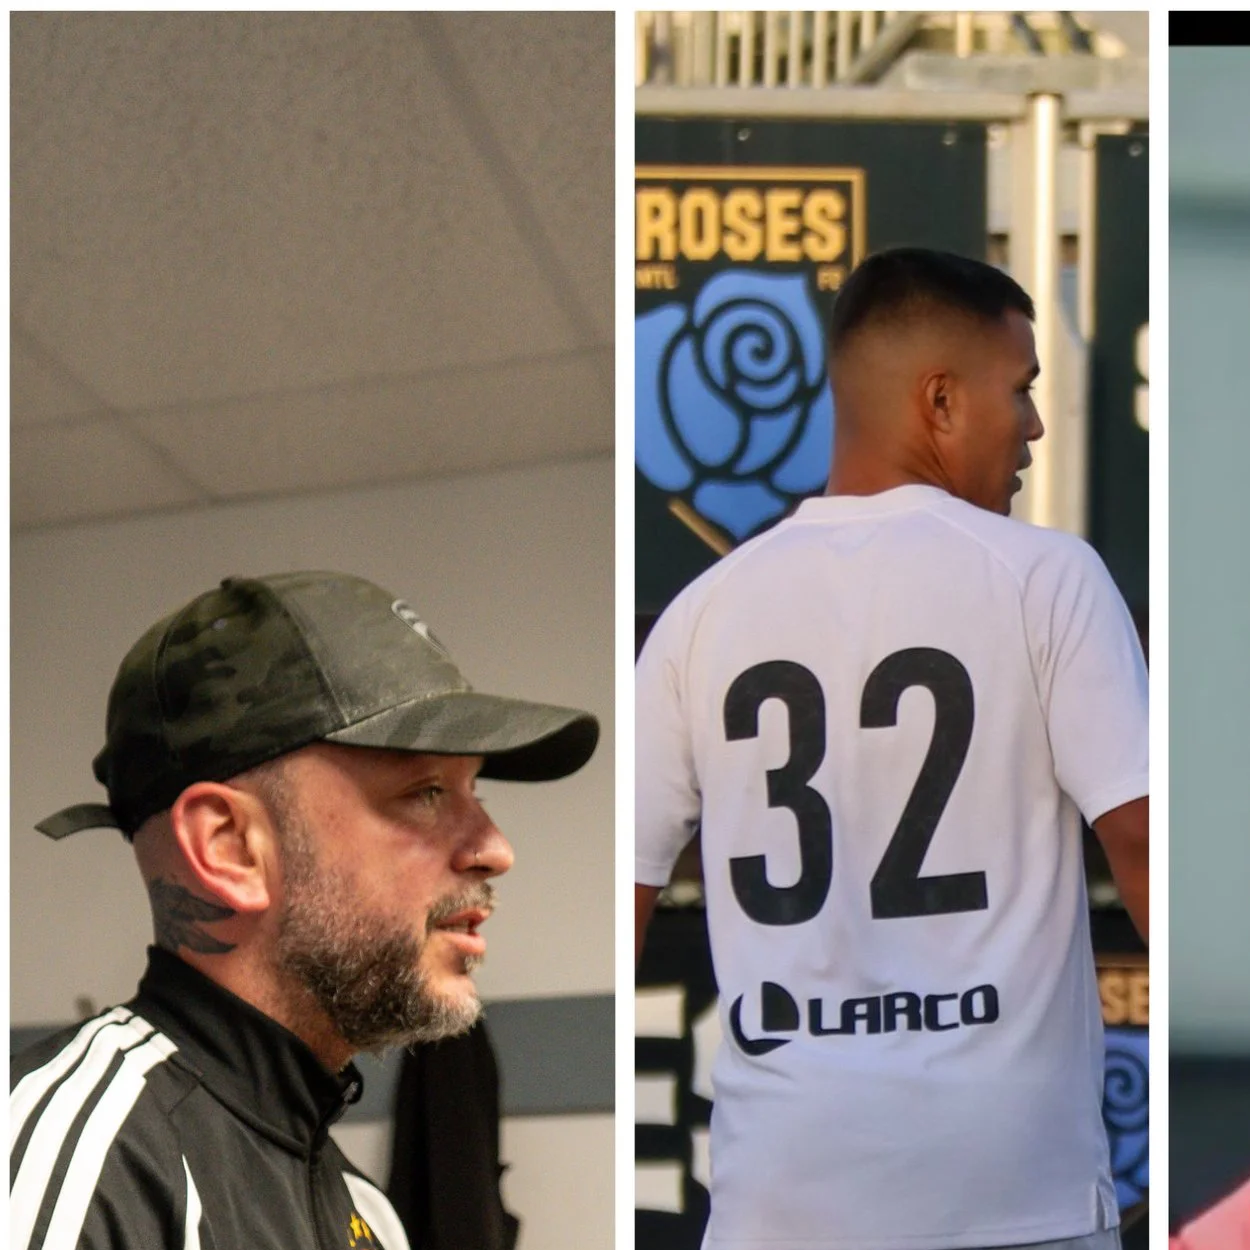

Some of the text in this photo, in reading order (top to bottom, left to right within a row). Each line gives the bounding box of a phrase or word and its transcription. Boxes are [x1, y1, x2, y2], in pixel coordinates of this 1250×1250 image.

[636, 186, 846, 262] ROSES
[723, 646, 988, 926] 32
[808, 984, 999, 1036] LARCO
